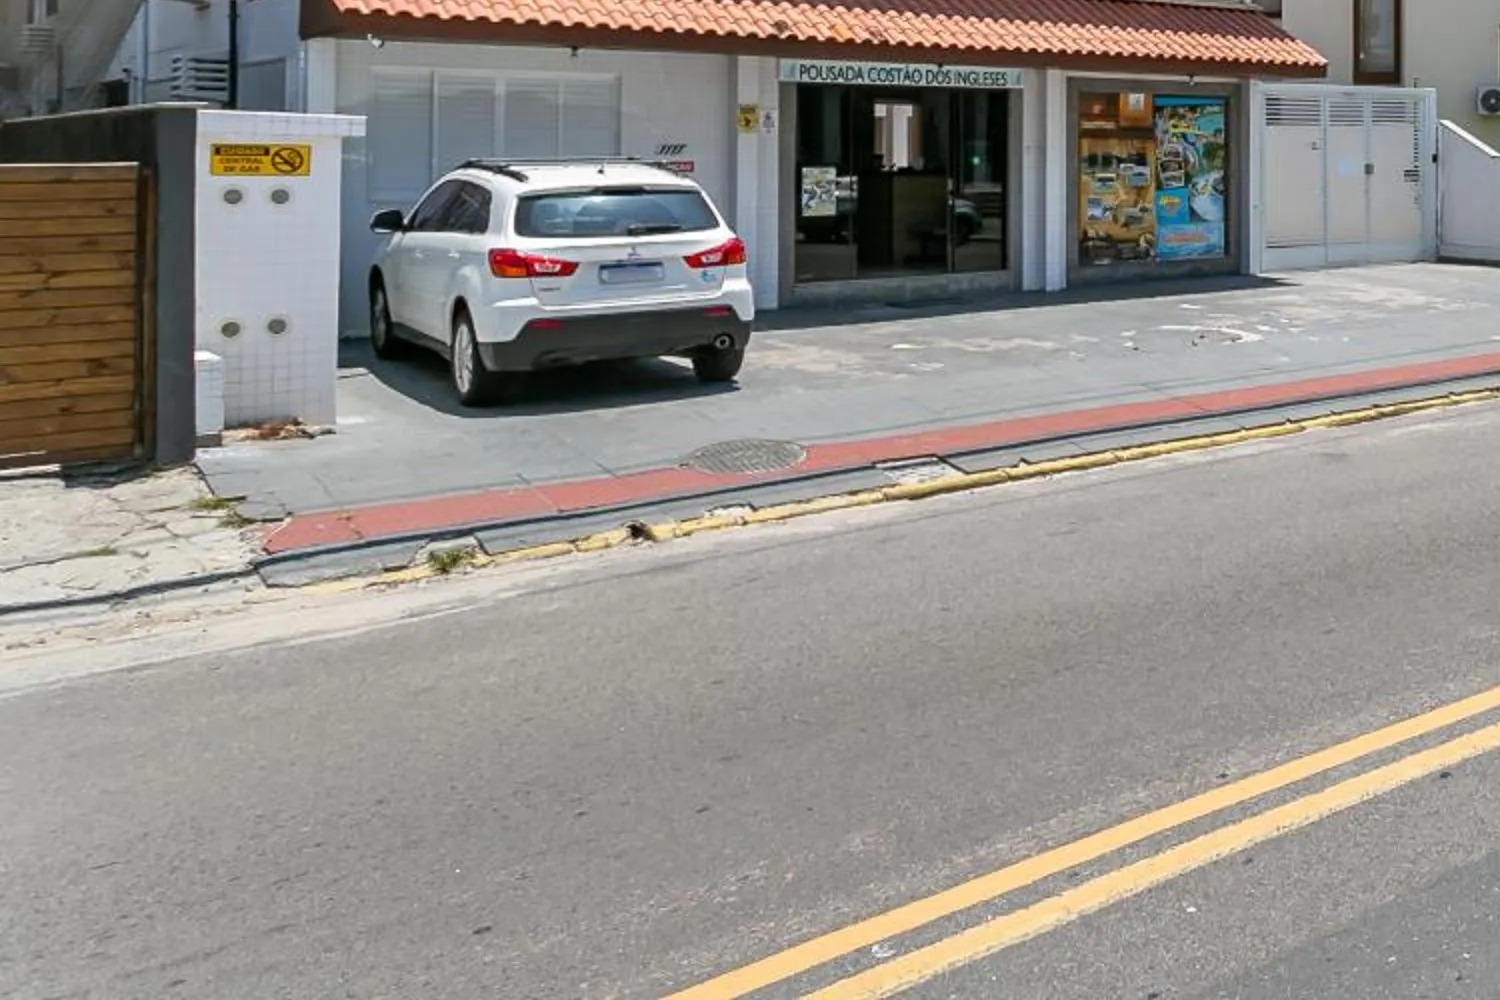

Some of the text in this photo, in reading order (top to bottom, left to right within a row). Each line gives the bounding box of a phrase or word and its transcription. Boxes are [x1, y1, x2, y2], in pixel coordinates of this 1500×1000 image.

[799, 63, 1009, 87] POUSADA COSTÃO DOS INGLESES
